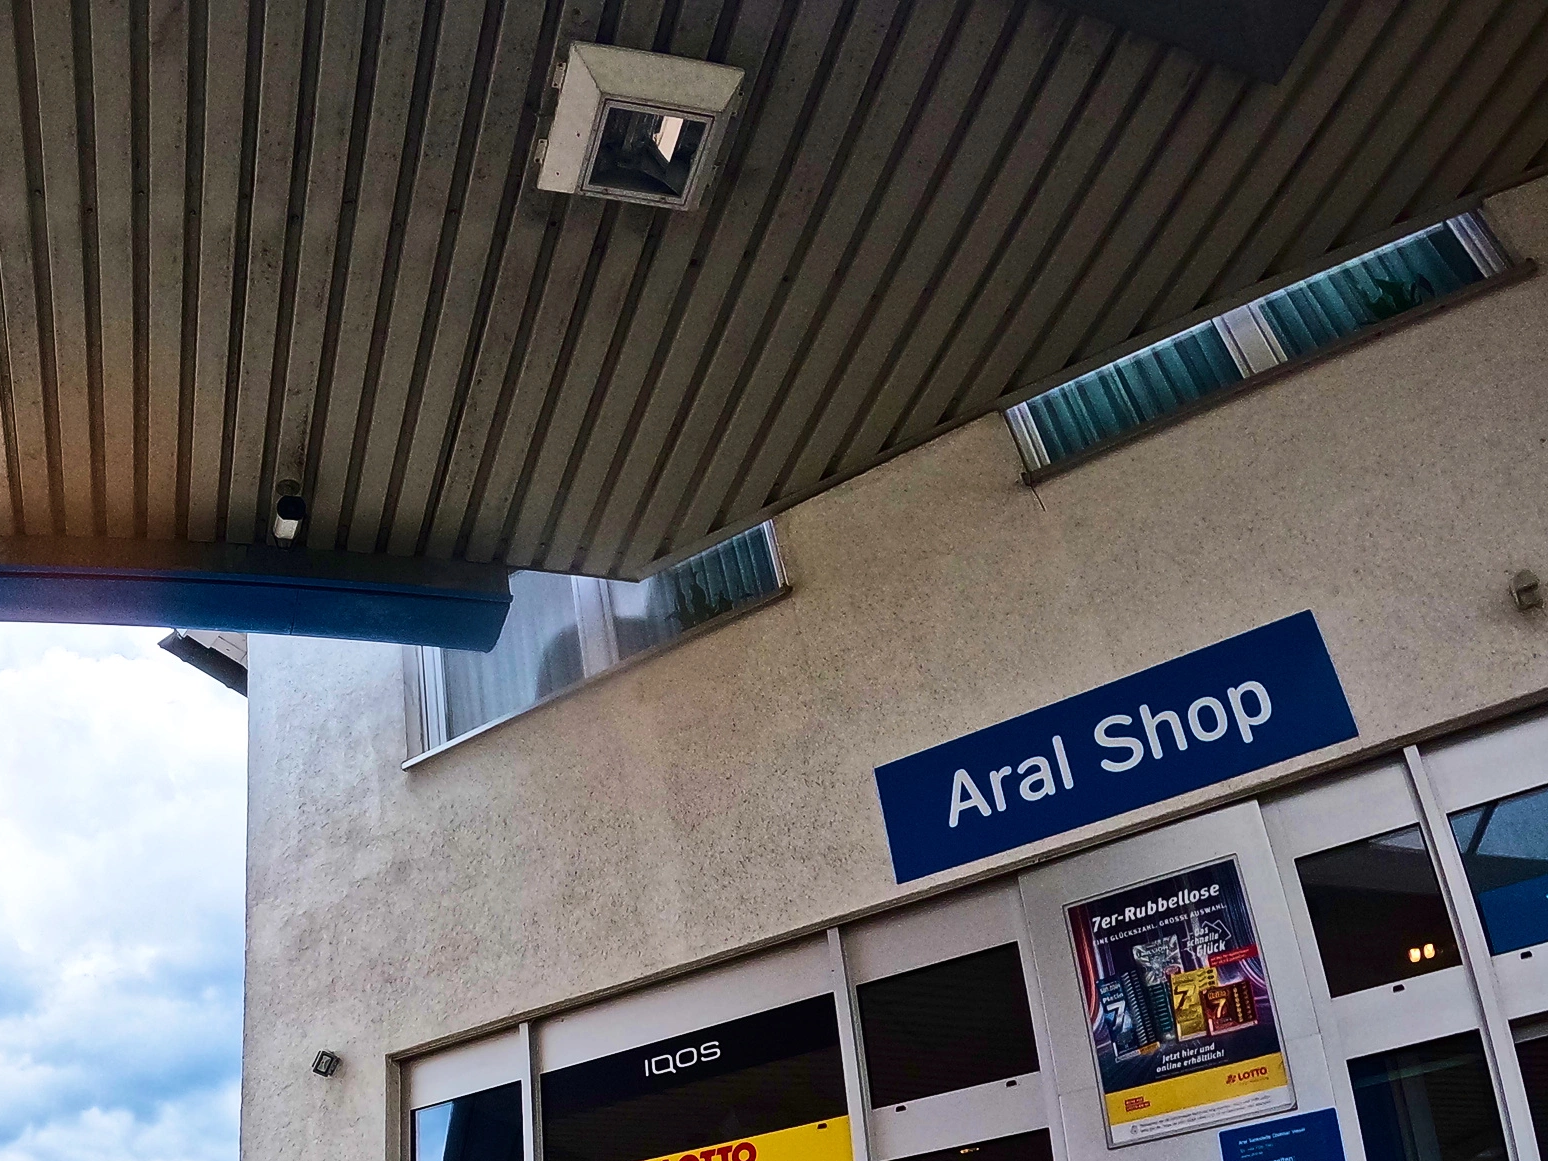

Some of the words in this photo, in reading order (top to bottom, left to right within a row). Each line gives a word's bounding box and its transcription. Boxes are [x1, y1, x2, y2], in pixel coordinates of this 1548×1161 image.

[949, 735, 1074, 828] Aral
[1094, 680, 1272, 773] Shop
[1092, 884, 1220, 933] 7er-Rubbellose
[1159, 914, 1189, 927] GROSSE
[1187, 932, 1219, 947] schnelle
[1196, 940, 1226, 957] Glück
[1106, 1000, 1126, 1029] 7
[1212, 998, 1227, 1018] 7
[644, 1041, 721, 1077] IQOS
[1156, 1061, 1182, 1073] online
[1183, 1049, 1225, 1067] erhältlich!
[1162, 1051, 1181, 1063] Jetzt
[1182, 1048, 1198, 1058] hier
[1199, 1042, 1215, 1053] und
[1237, 1066, 1268, 1082] LOTTO
